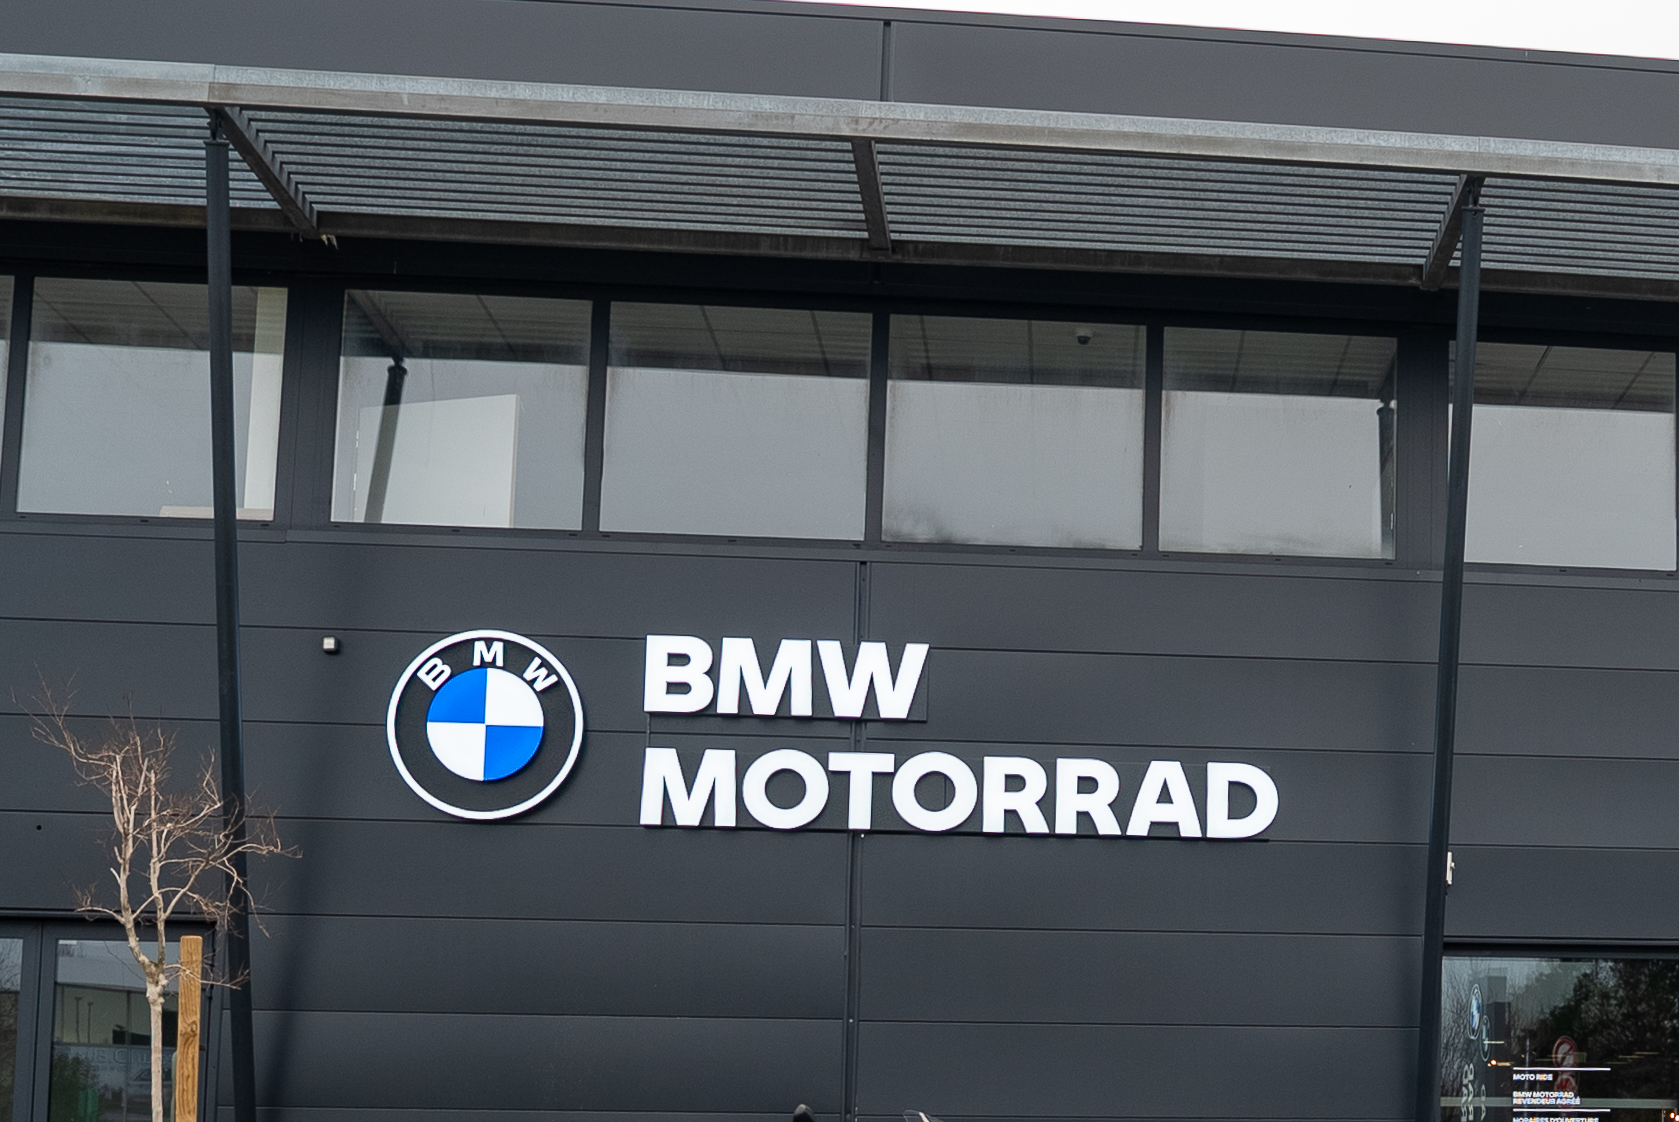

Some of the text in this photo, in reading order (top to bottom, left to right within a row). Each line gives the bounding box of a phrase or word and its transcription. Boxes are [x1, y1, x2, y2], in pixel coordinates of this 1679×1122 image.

[417, 641, 558, 691] BMW
[643, 635, 930, 719] BMW
[639, 747, 1279, 839] MOTORRAD
[1513, 1073, 1535, 1081] MOTO
